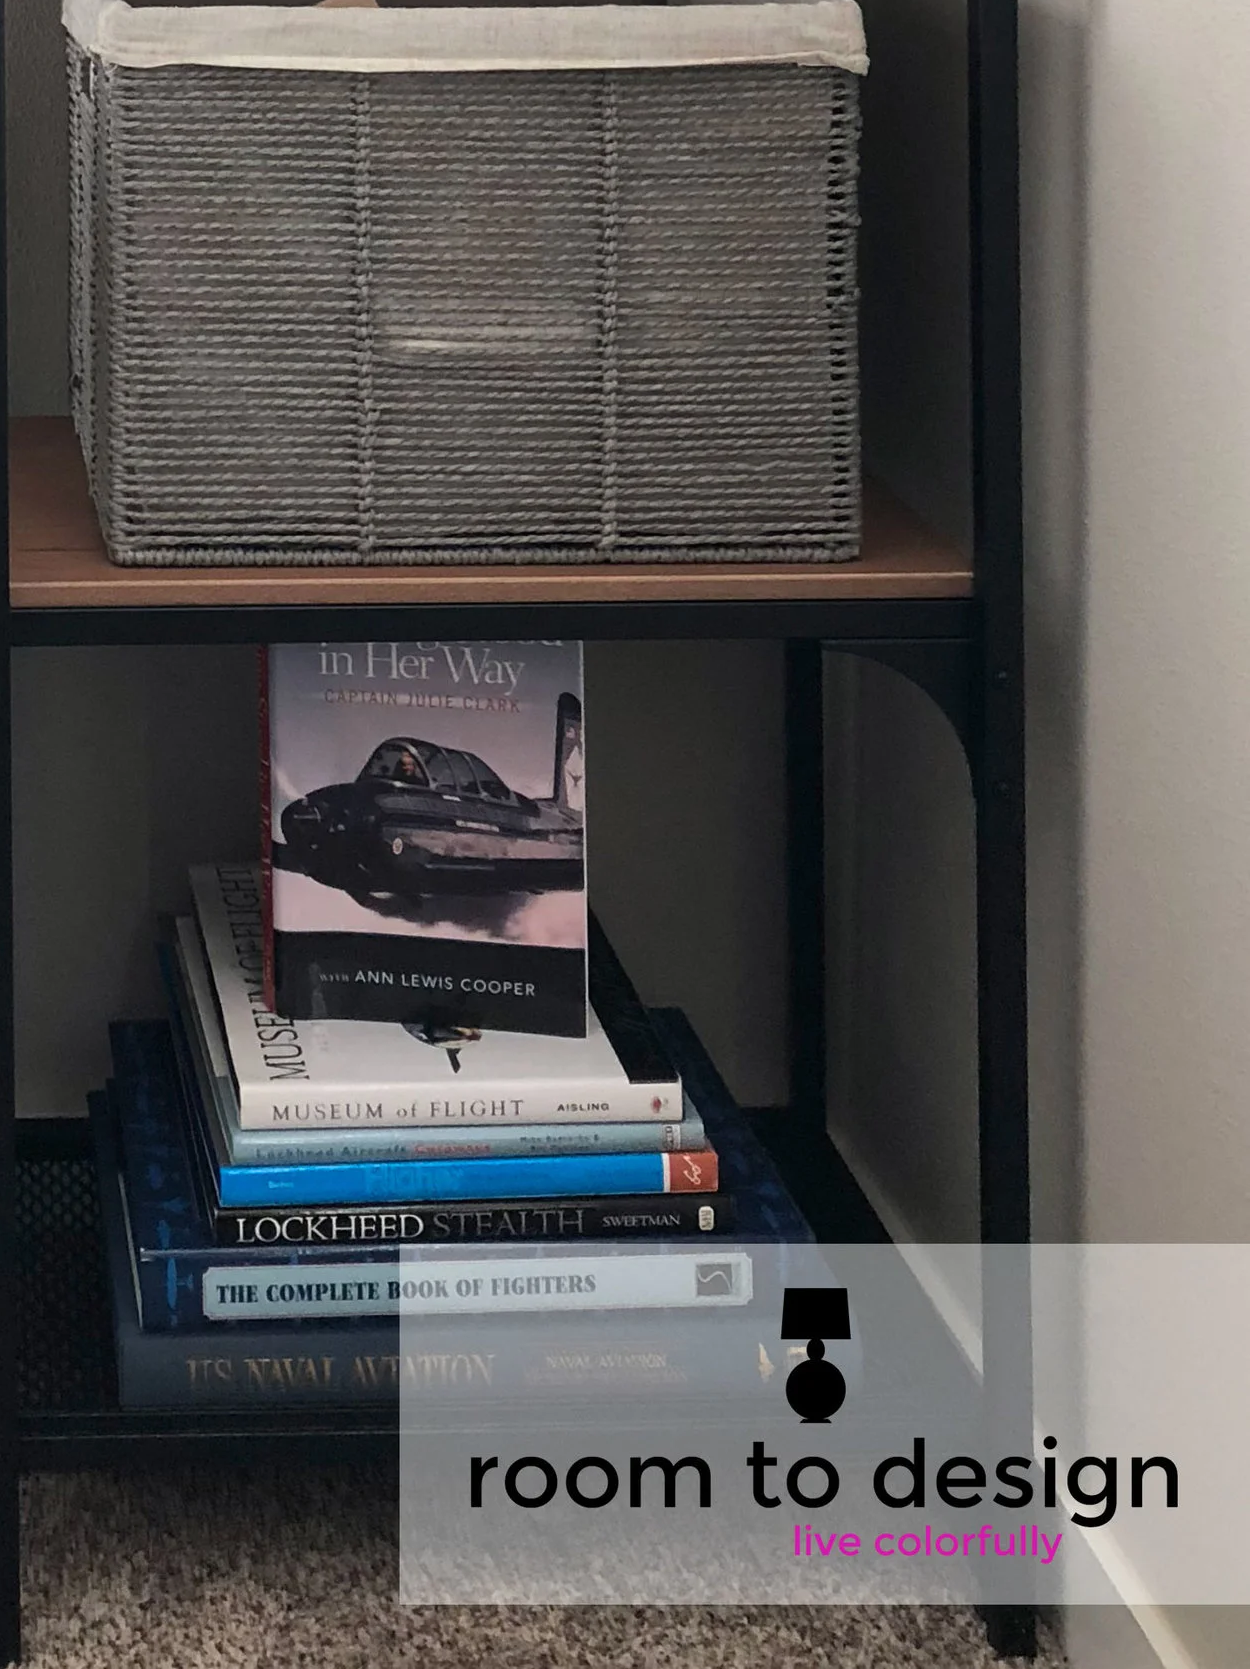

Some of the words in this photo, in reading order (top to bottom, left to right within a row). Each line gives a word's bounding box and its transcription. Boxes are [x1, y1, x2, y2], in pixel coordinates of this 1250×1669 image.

[318, 642, 354, 677] in
[364, 644, 435, 680] Her
[442, 647, 527, 696] Way
[324, 688, 398, 707] CAPTAIN
[406, 693, 453, 710] JULIE
[461, 696, 521, 714] CLARK
[354, 969, 395, 986] ANN
[400, 972, 454, 992] LEWIS
[460, 978, 537, 999] COOPER
[273, 1100, 383, 1122] MUSEUM
[395, 1103, 418, 1118] of
[429, 1099, 525, 1119] FLIGHT
[556, 1102, 610, 1113] AISLING
[235, 1213, 425, 1244] LOCKHEED
[432, 1209, 584, 1238] STEALTH
[601, 1214, 682, 1229] SWEETMAN
[215, 1283, 259, 1305] THE
[265, 1280, 382, 1304] COMPLETE
[387, 1277, 450, 1301] BOOK
[455, 1277, 483, 1298] OF
[491, 1274, 597, 1297] FIGHTERS
